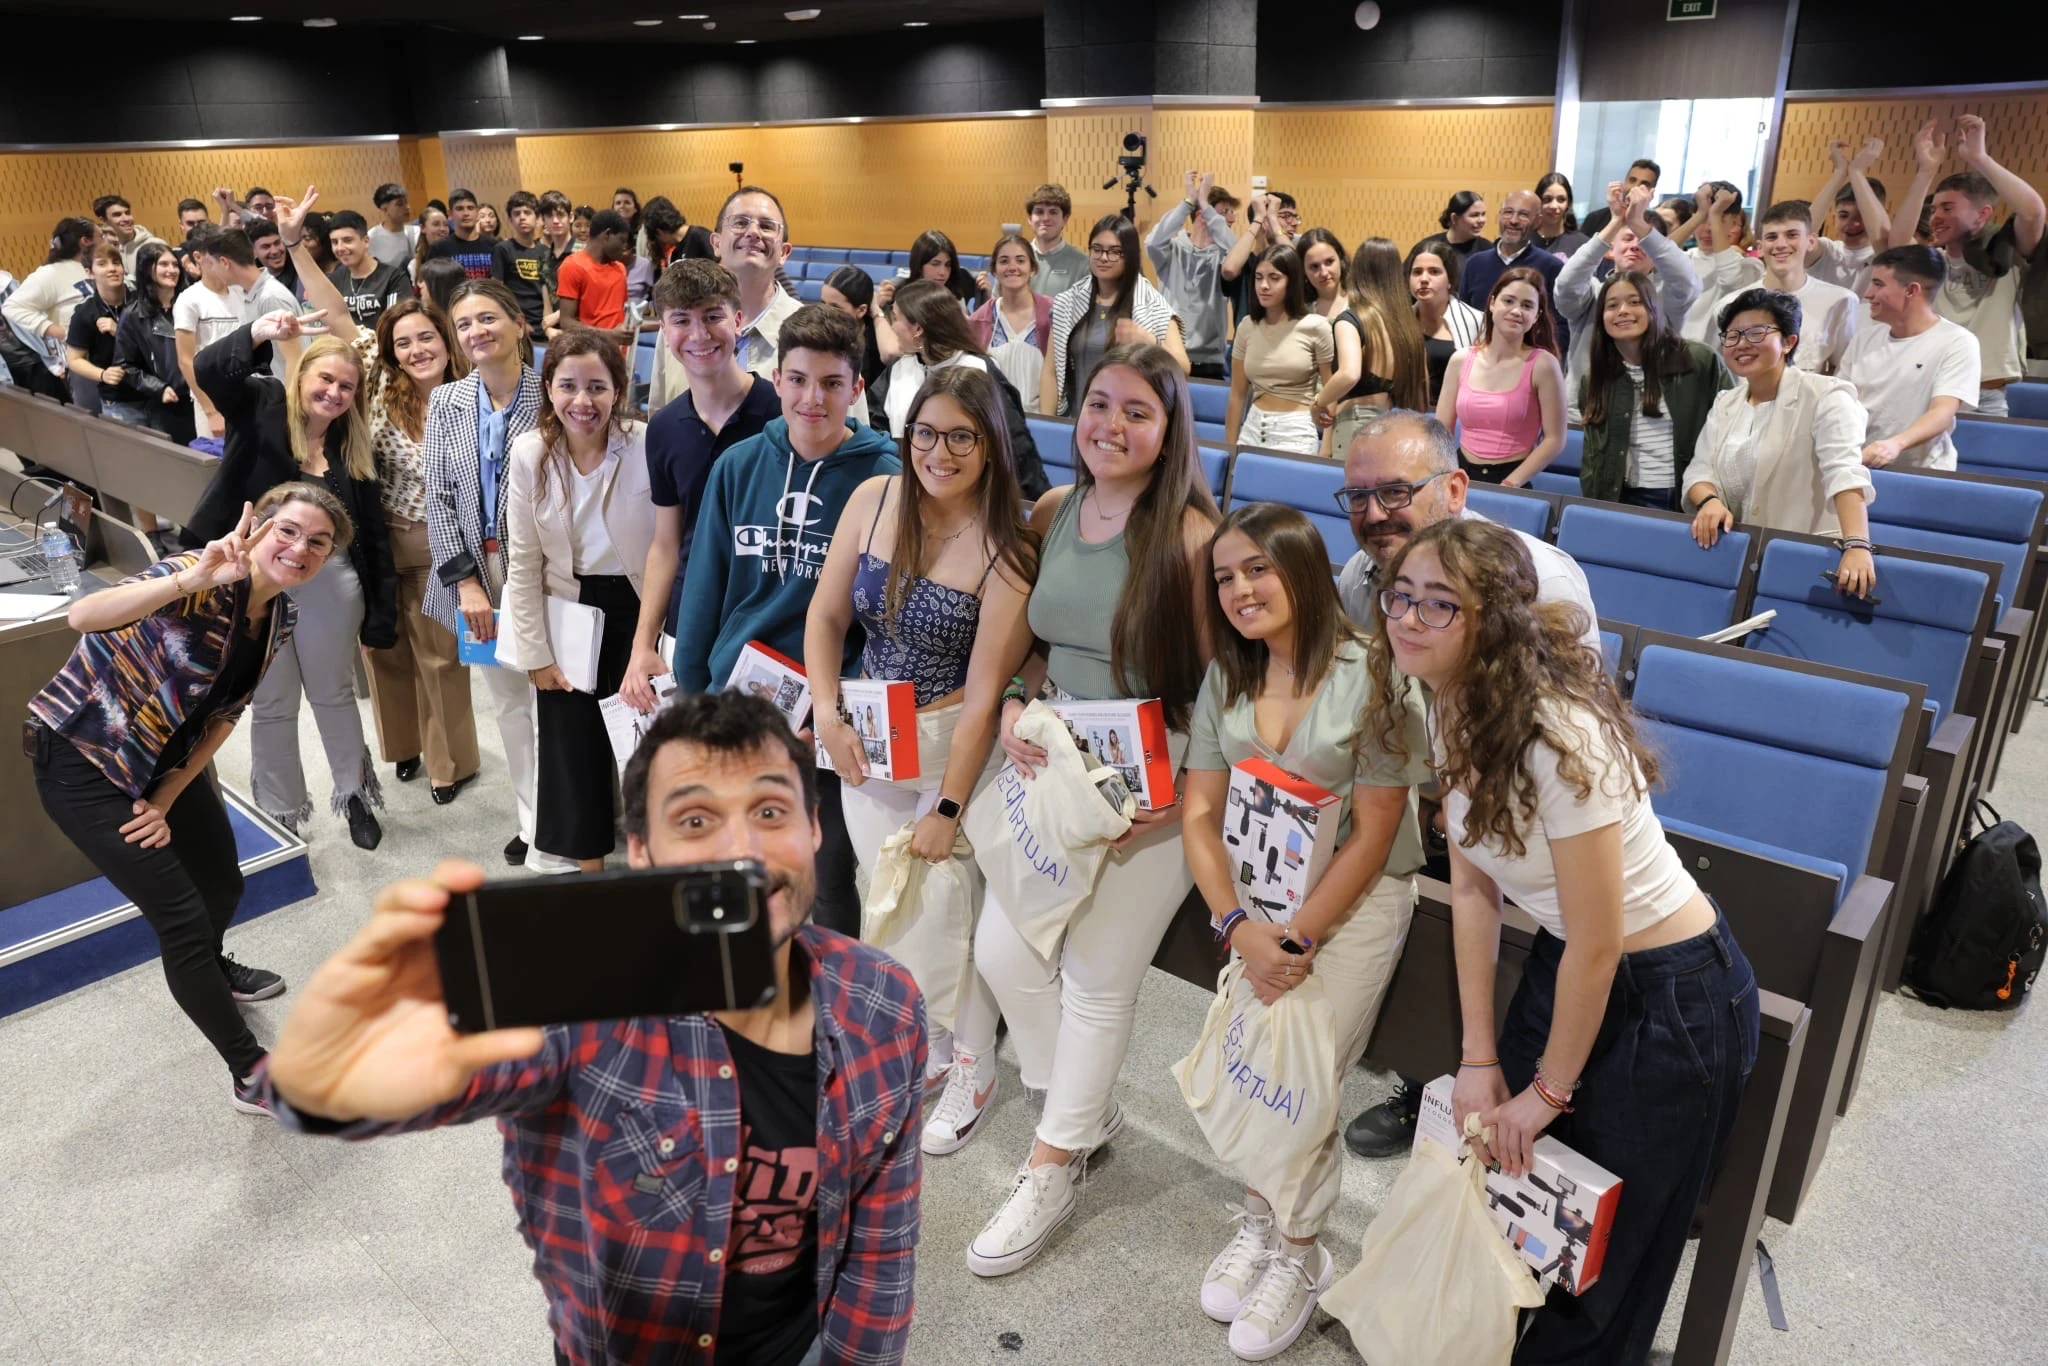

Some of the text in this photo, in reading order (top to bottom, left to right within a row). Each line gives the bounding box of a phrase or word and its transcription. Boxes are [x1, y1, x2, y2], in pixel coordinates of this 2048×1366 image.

[1682, 2, 1702, 13] EXIT
[736, 527, 829, 560] Champi
[761, 558, 788, 573] NEW
[1423, 1093, 1452, 1116] INFLU
